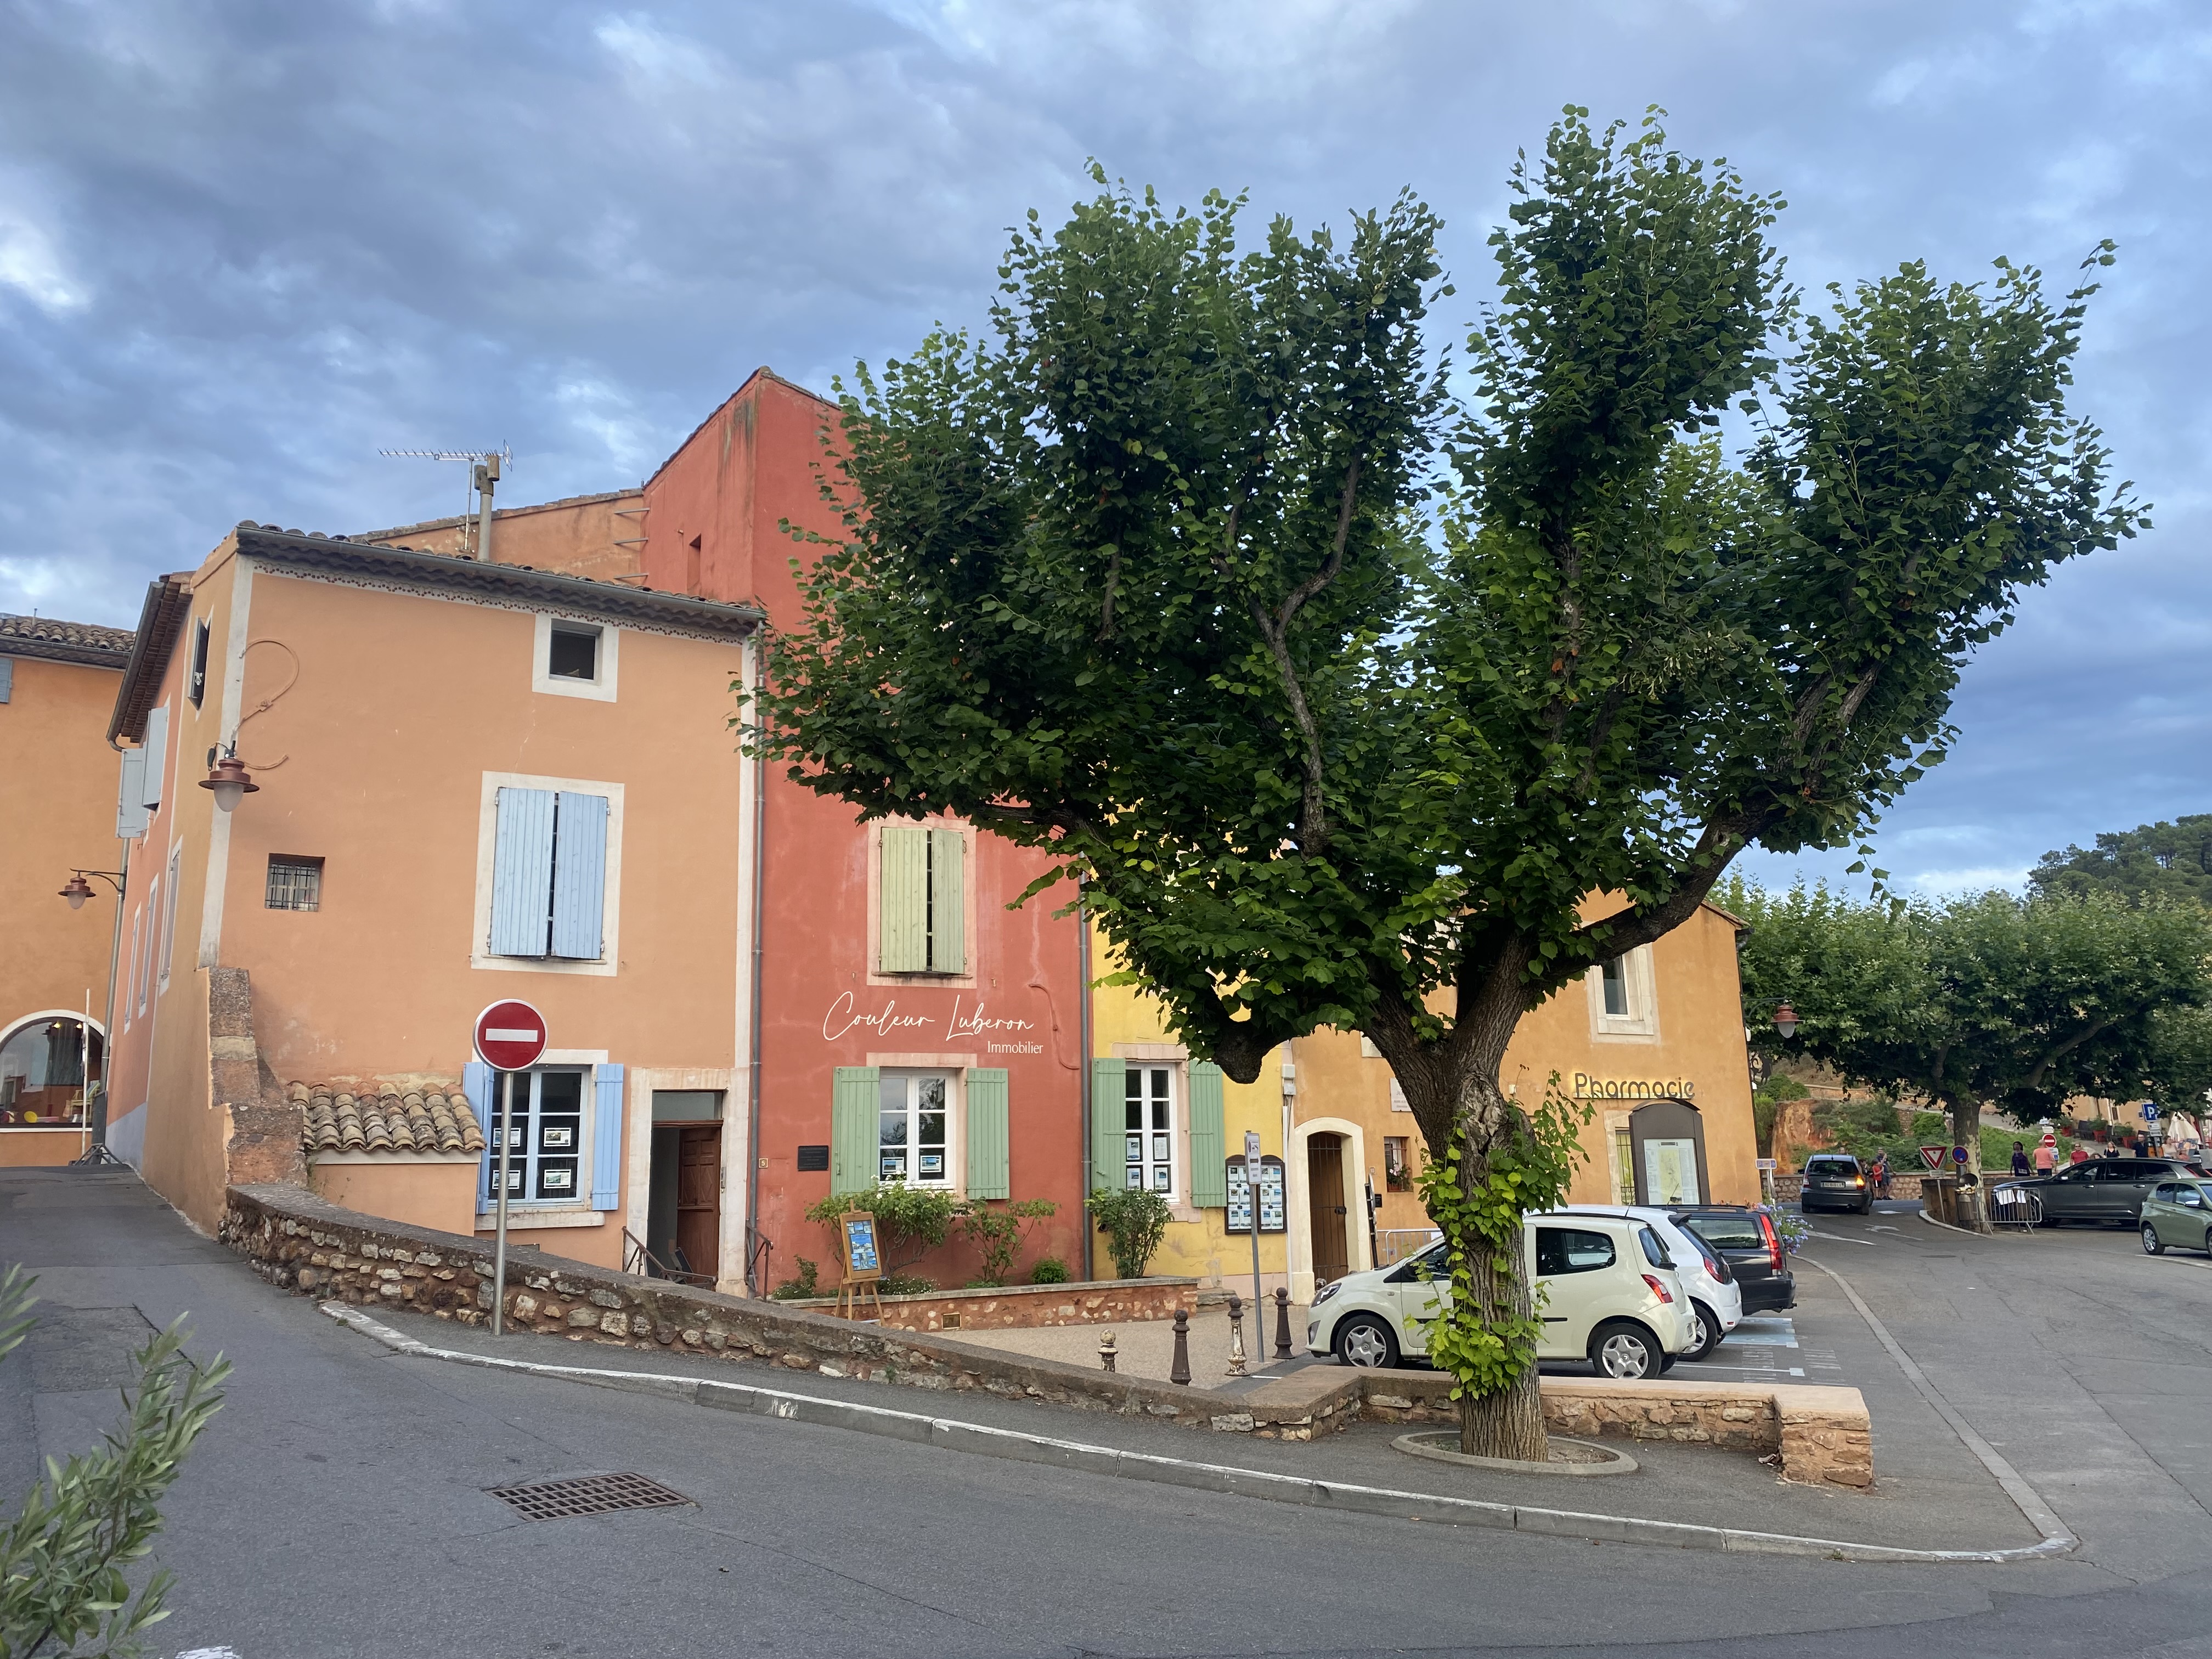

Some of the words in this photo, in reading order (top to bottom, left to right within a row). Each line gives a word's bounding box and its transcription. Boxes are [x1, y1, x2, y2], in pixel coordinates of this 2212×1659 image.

[823, 991, 935, 1041] Couleur
[946, 994, 1034, 1041] Luberon
[987, 1041, 1043, 1054] Immobilier
[1575, 1073, 1695, 1098] Pharmacie
[2147, 1107, 2155, 1118] P
